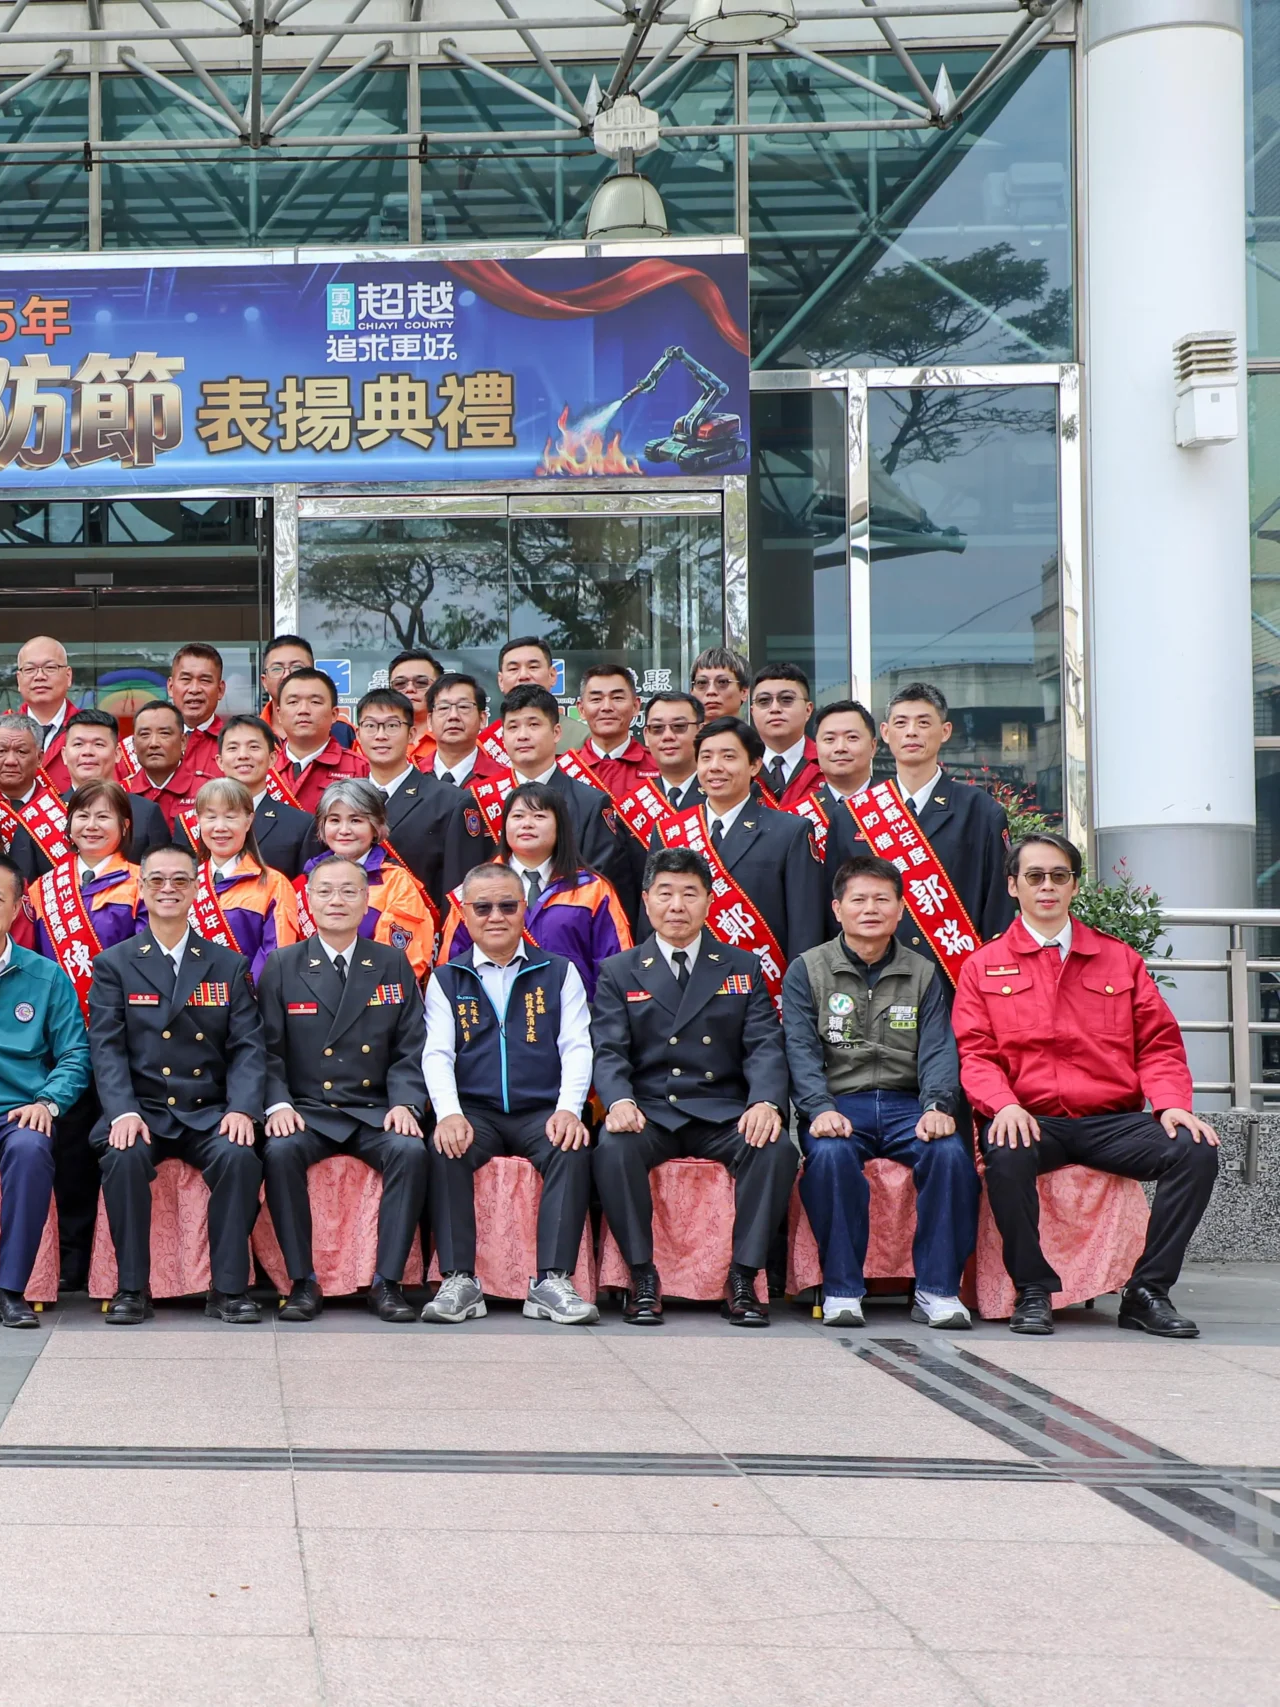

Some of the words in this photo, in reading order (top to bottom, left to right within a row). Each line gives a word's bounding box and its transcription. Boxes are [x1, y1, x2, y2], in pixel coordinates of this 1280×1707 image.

[331, 285, 351, 326] 勇敢
[357, 281, 454, 320] 超越
[358, 321, 398, 331] CHIAYI
[404, 320, 454, 329] COUNTY
[326, 333, 458, 362] 追求更好。
[197, 372, 516, 454] 表揚典禮
[851, 793, 910, 875] 消防楷模
[871, 782, 930, 867] 嘉義縣114年度
[908, 873, 975, 956] 郭瑞
[63, 939, 94, 984] 陳
[535, 986, 546, 1014] 嘉義縣
